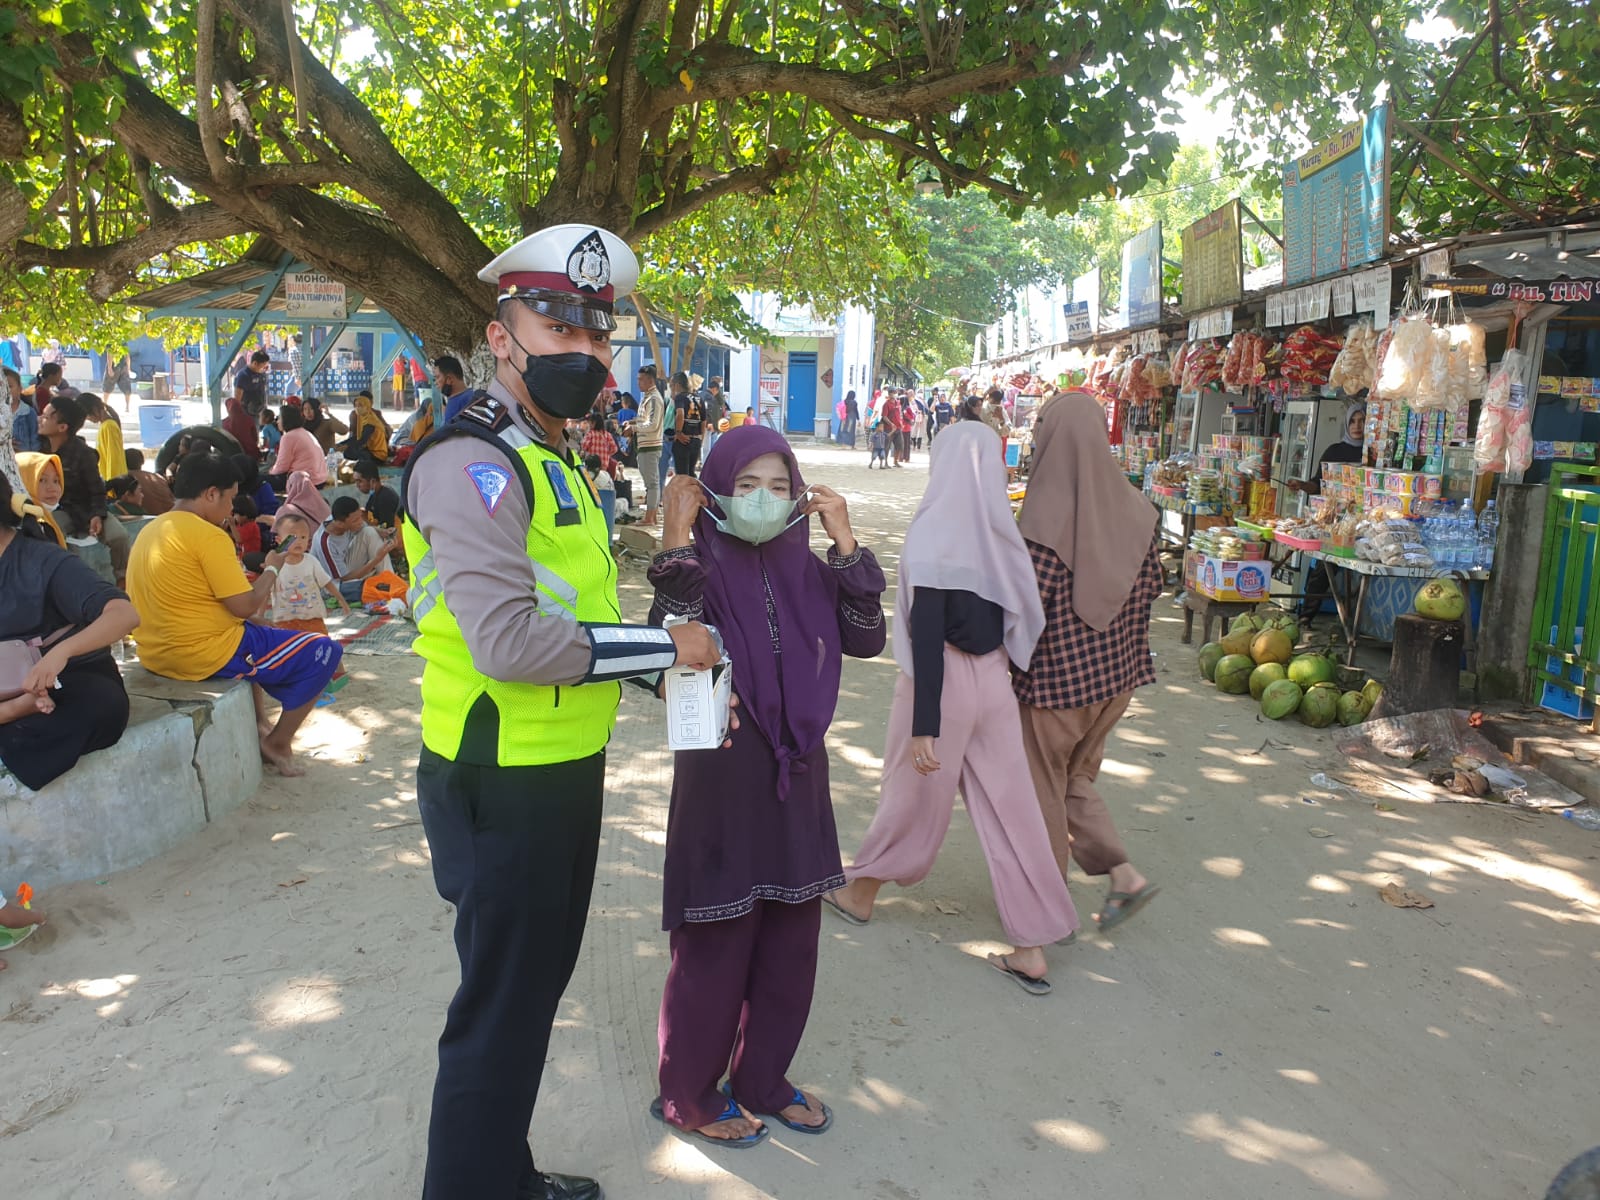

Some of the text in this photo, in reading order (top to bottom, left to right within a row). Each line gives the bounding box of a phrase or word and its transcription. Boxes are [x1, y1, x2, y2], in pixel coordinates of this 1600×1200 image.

[1301, 152, 1321, 170] Warung
[295, 274, 334, 284] MOHON
[287, 283, 343, 295] BUANG SAMPAH
[288, 293, 342, 303] PADA TEMPATNYA
[1068, 321, 1090, 332] ATM
[760, 381, 779, 390] UTUP
